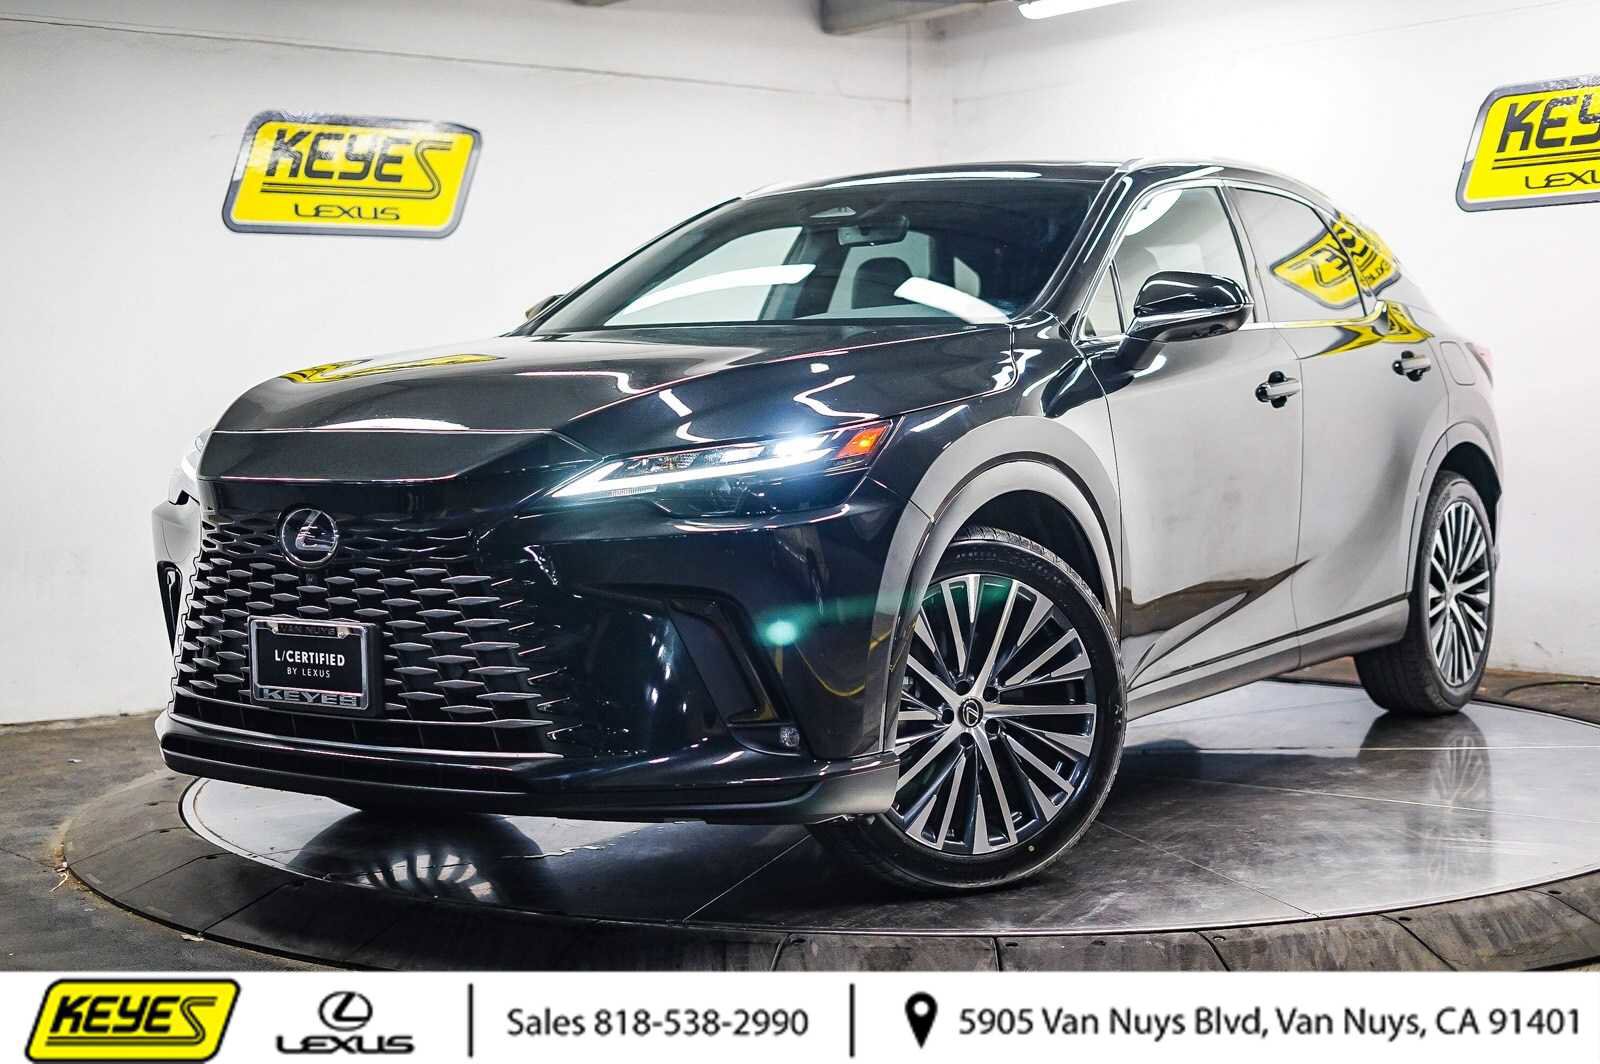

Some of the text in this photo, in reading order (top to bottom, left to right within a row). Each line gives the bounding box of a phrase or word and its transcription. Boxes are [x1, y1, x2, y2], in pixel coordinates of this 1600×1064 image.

[265, 128, 453, 200] KEYES
[294, 203, 400, 221] LEXUS
[274, 649, 345, 667] L/CERTIFIED
[287, 667, 331, 679] BY LEXUS
[263, 688, 358, 706] KEYES
